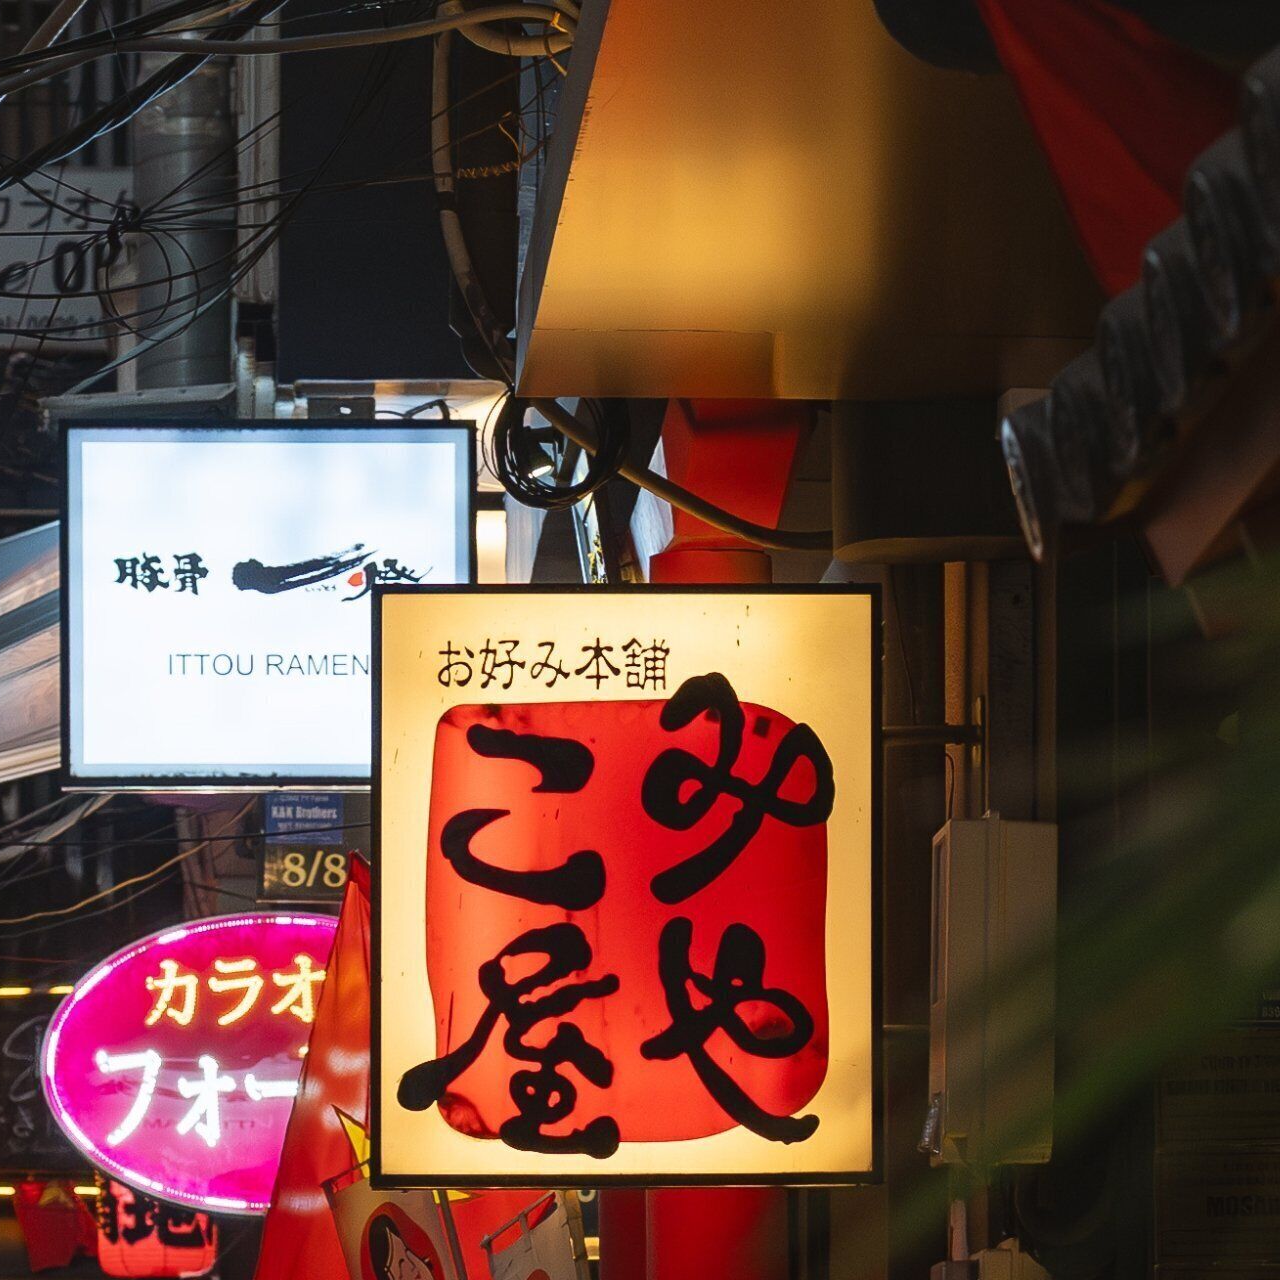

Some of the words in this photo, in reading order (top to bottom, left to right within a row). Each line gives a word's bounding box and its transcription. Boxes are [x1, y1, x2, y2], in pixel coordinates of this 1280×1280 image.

[169, 653, 254, 676] ITTOU
[266, 653, 370, 676] RAMEN
[282, 850, 347, 888] 8/8
